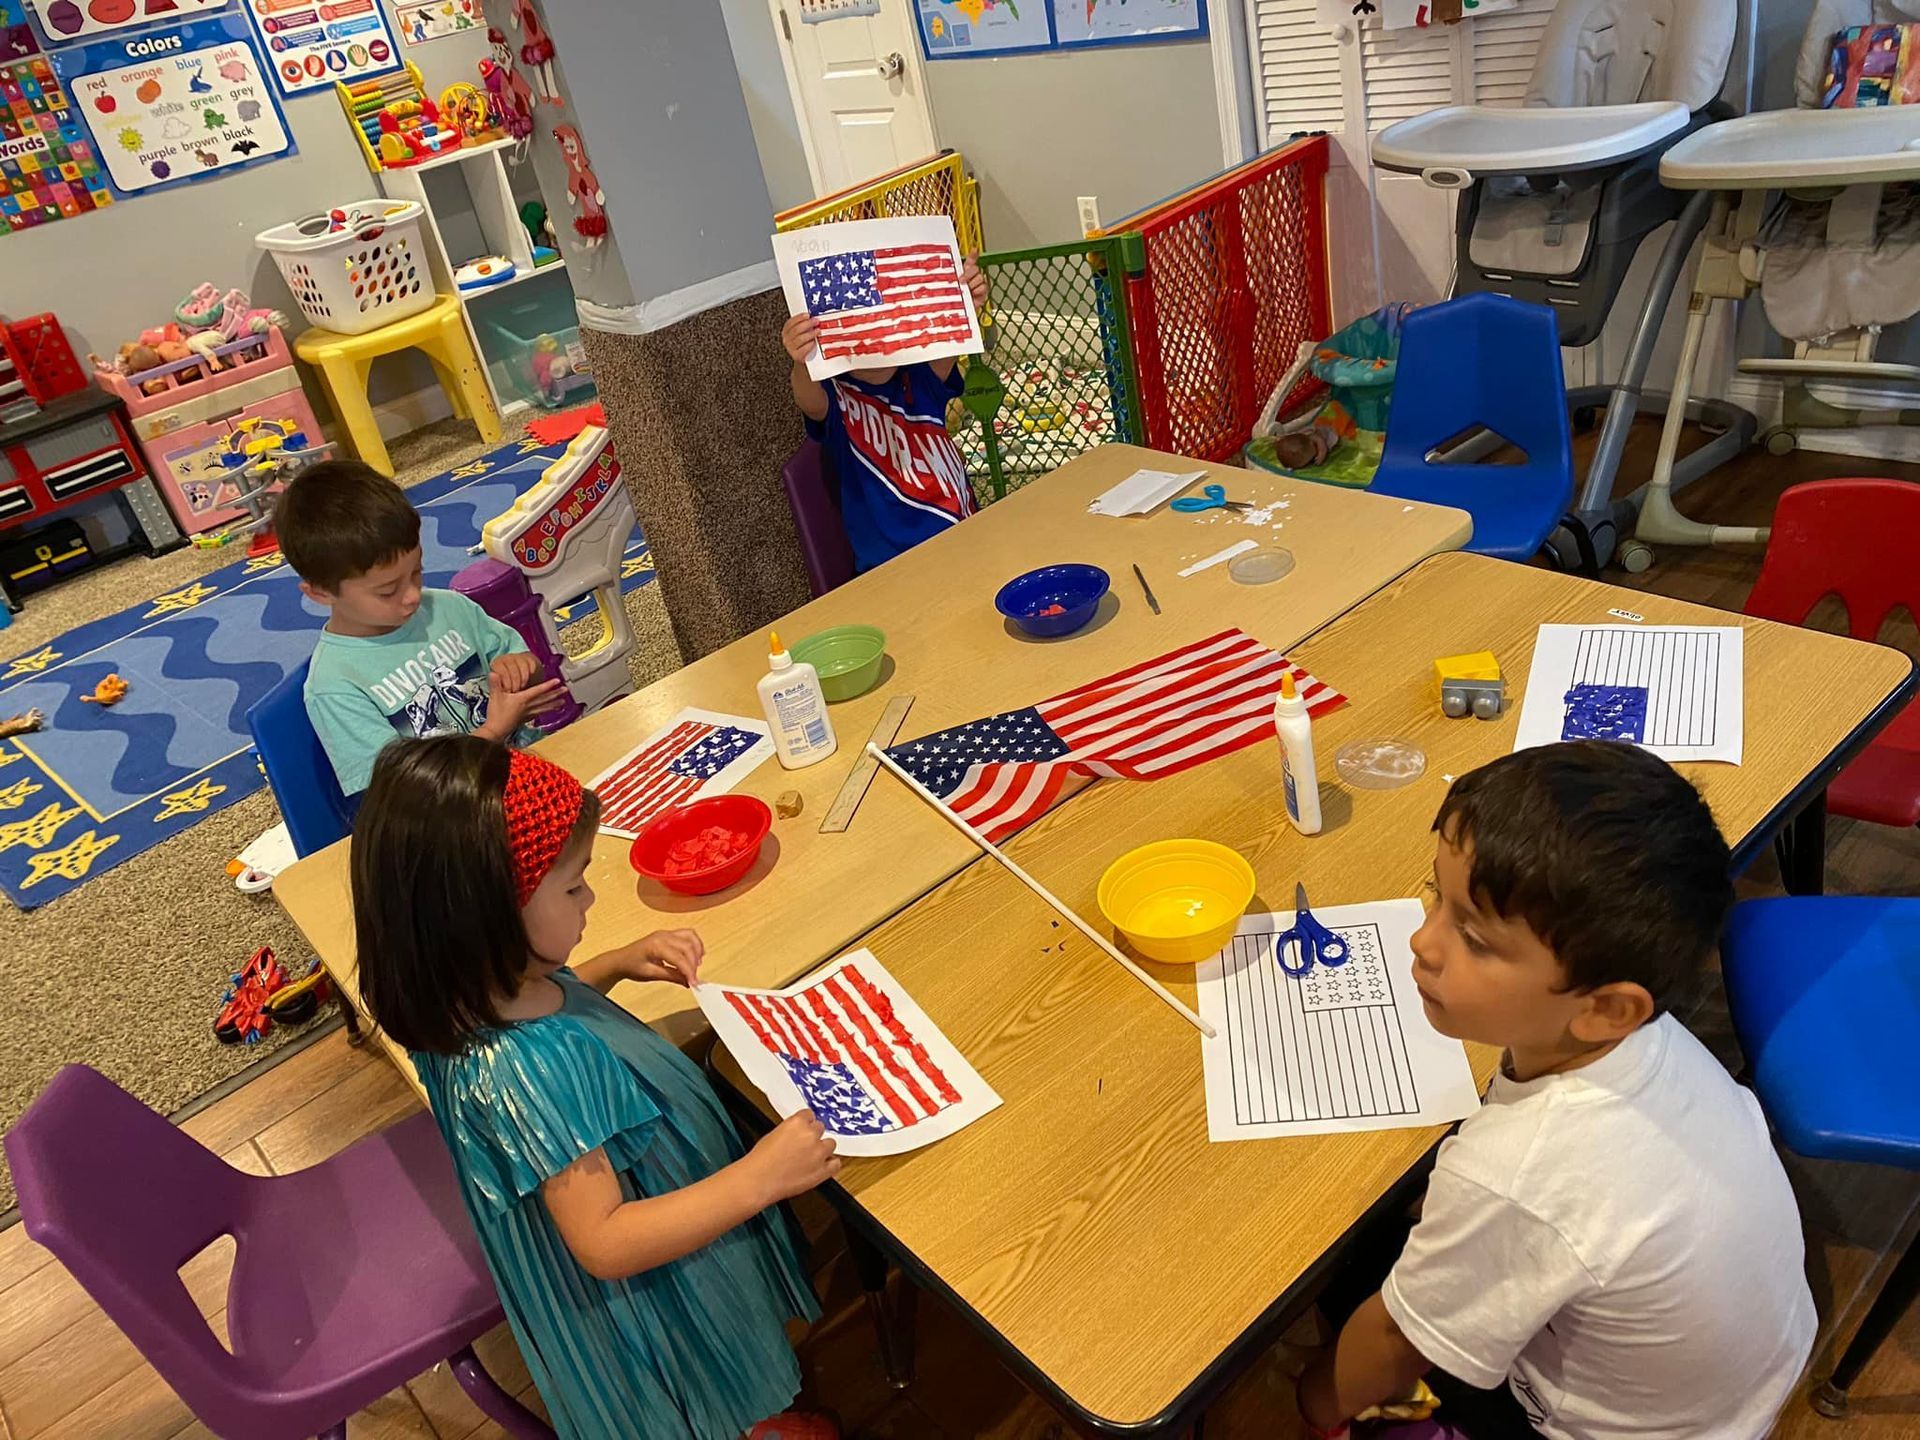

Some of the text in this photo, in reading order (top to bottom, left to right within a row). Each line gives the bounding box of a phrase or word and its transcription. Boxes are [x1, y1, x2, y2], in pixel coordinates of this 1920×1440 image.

[125, 34, 183, 58] Colors
[86, 48, 240, 91] red orange blue pink
[190, 93, 223, 110] green
[230, 85, 254, 100] grey
[139, 126, 254, 165] purple brown black
[370, 629, 471, 709] DINOSAUR
